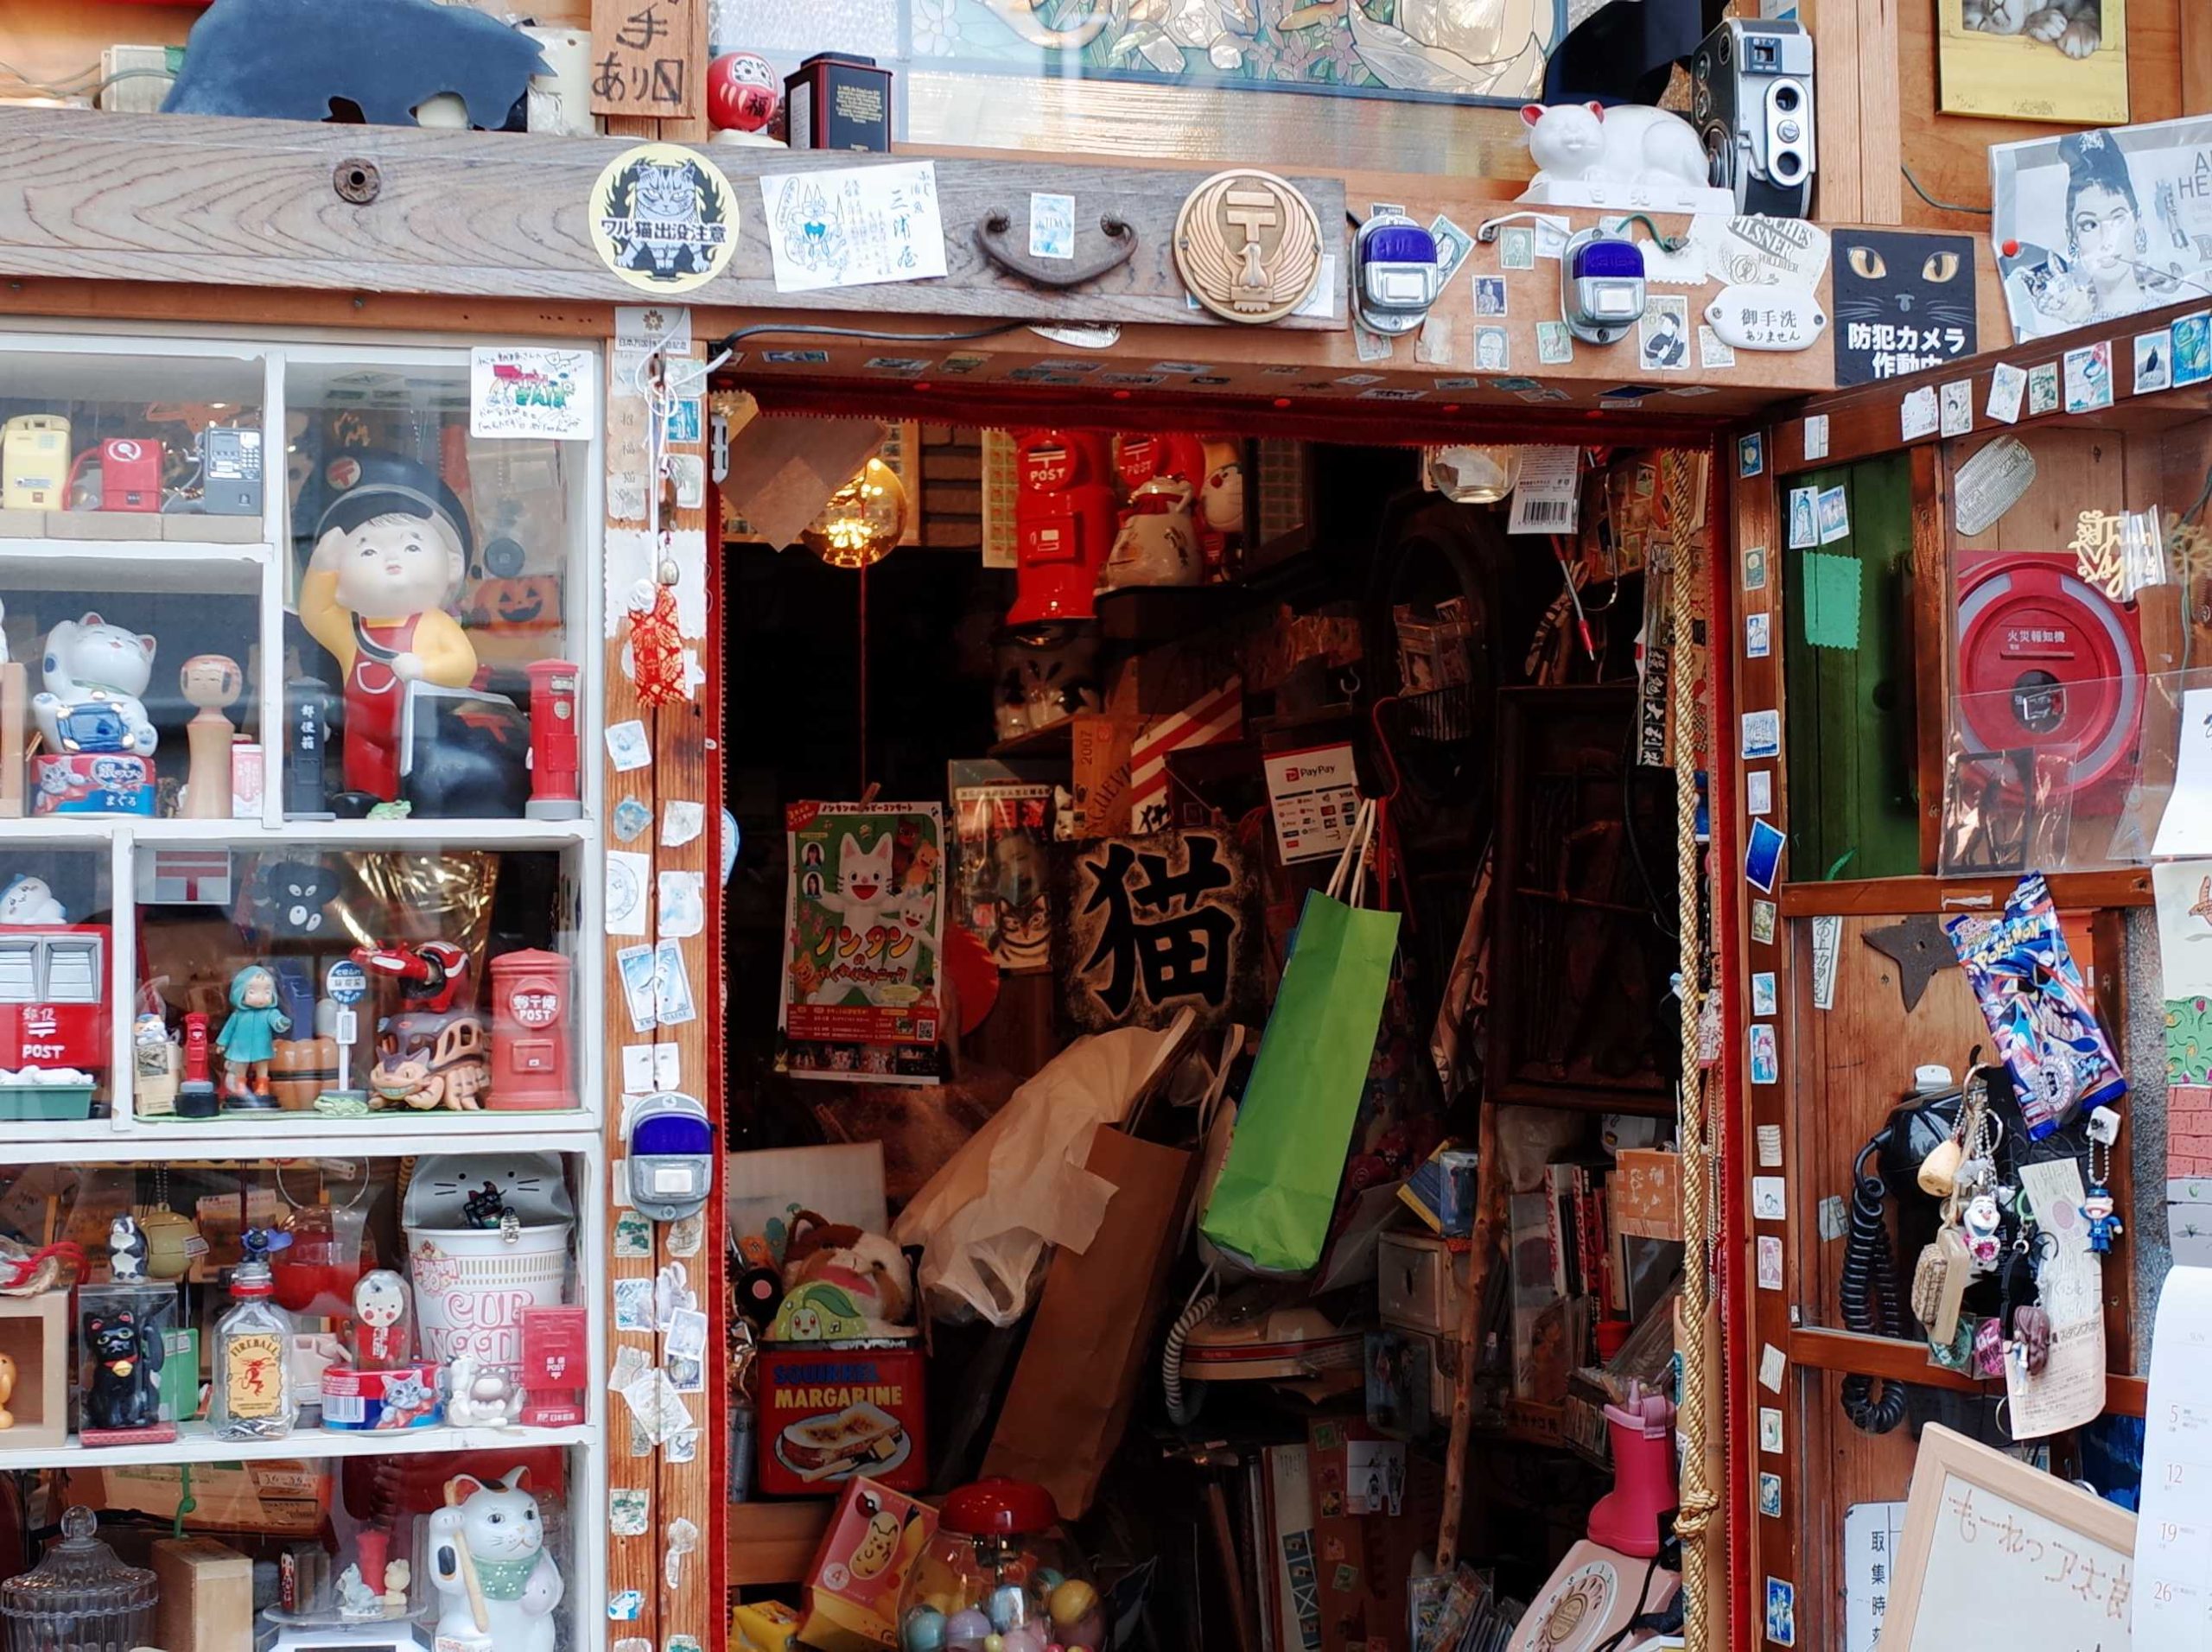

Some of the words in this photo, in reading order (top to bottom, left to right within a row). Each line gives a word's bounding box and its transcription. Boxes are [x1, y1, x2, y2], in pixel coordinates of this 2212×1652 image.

[744, 93, 769, 118] 福
[601, 219, 727, 243] ワル猫出没注意
[1726, 215, 1795, 261] PILSNER
[1740, 308, 1798, 327] 御手洗
[1745, 330, 1801, 343] ありません
[1847, 322, 1966, 353] 防犯カメラ
[1030, 468, 1065, 482] POST
[1126, 460, 1152, 476] POST
[2007, 630, 2066, 644] 火災報知機
[1081, 730, 1093, 765] 2007
[1300, 765, 1336, 778] PayPay
[1080, 836, 1236, 1019] 猫
[816, 925, 914, 959] ノンタン
[519, 1009, 551, 1021] POST
[22, 1044, 66, 1059] POST
[442, 1288, 534, 1331] CUP
[230, 1339, 278, 1357] FIREBALL
[774, 1386, 903, 1409] MARGARINE
[2170, 1404, 2178, 1424] 5
[2166, 1464, 2183, 1484] 12
[2160, 1522, 2177, 1542] 19
[2154, 1581, 2172, 1602] 26
